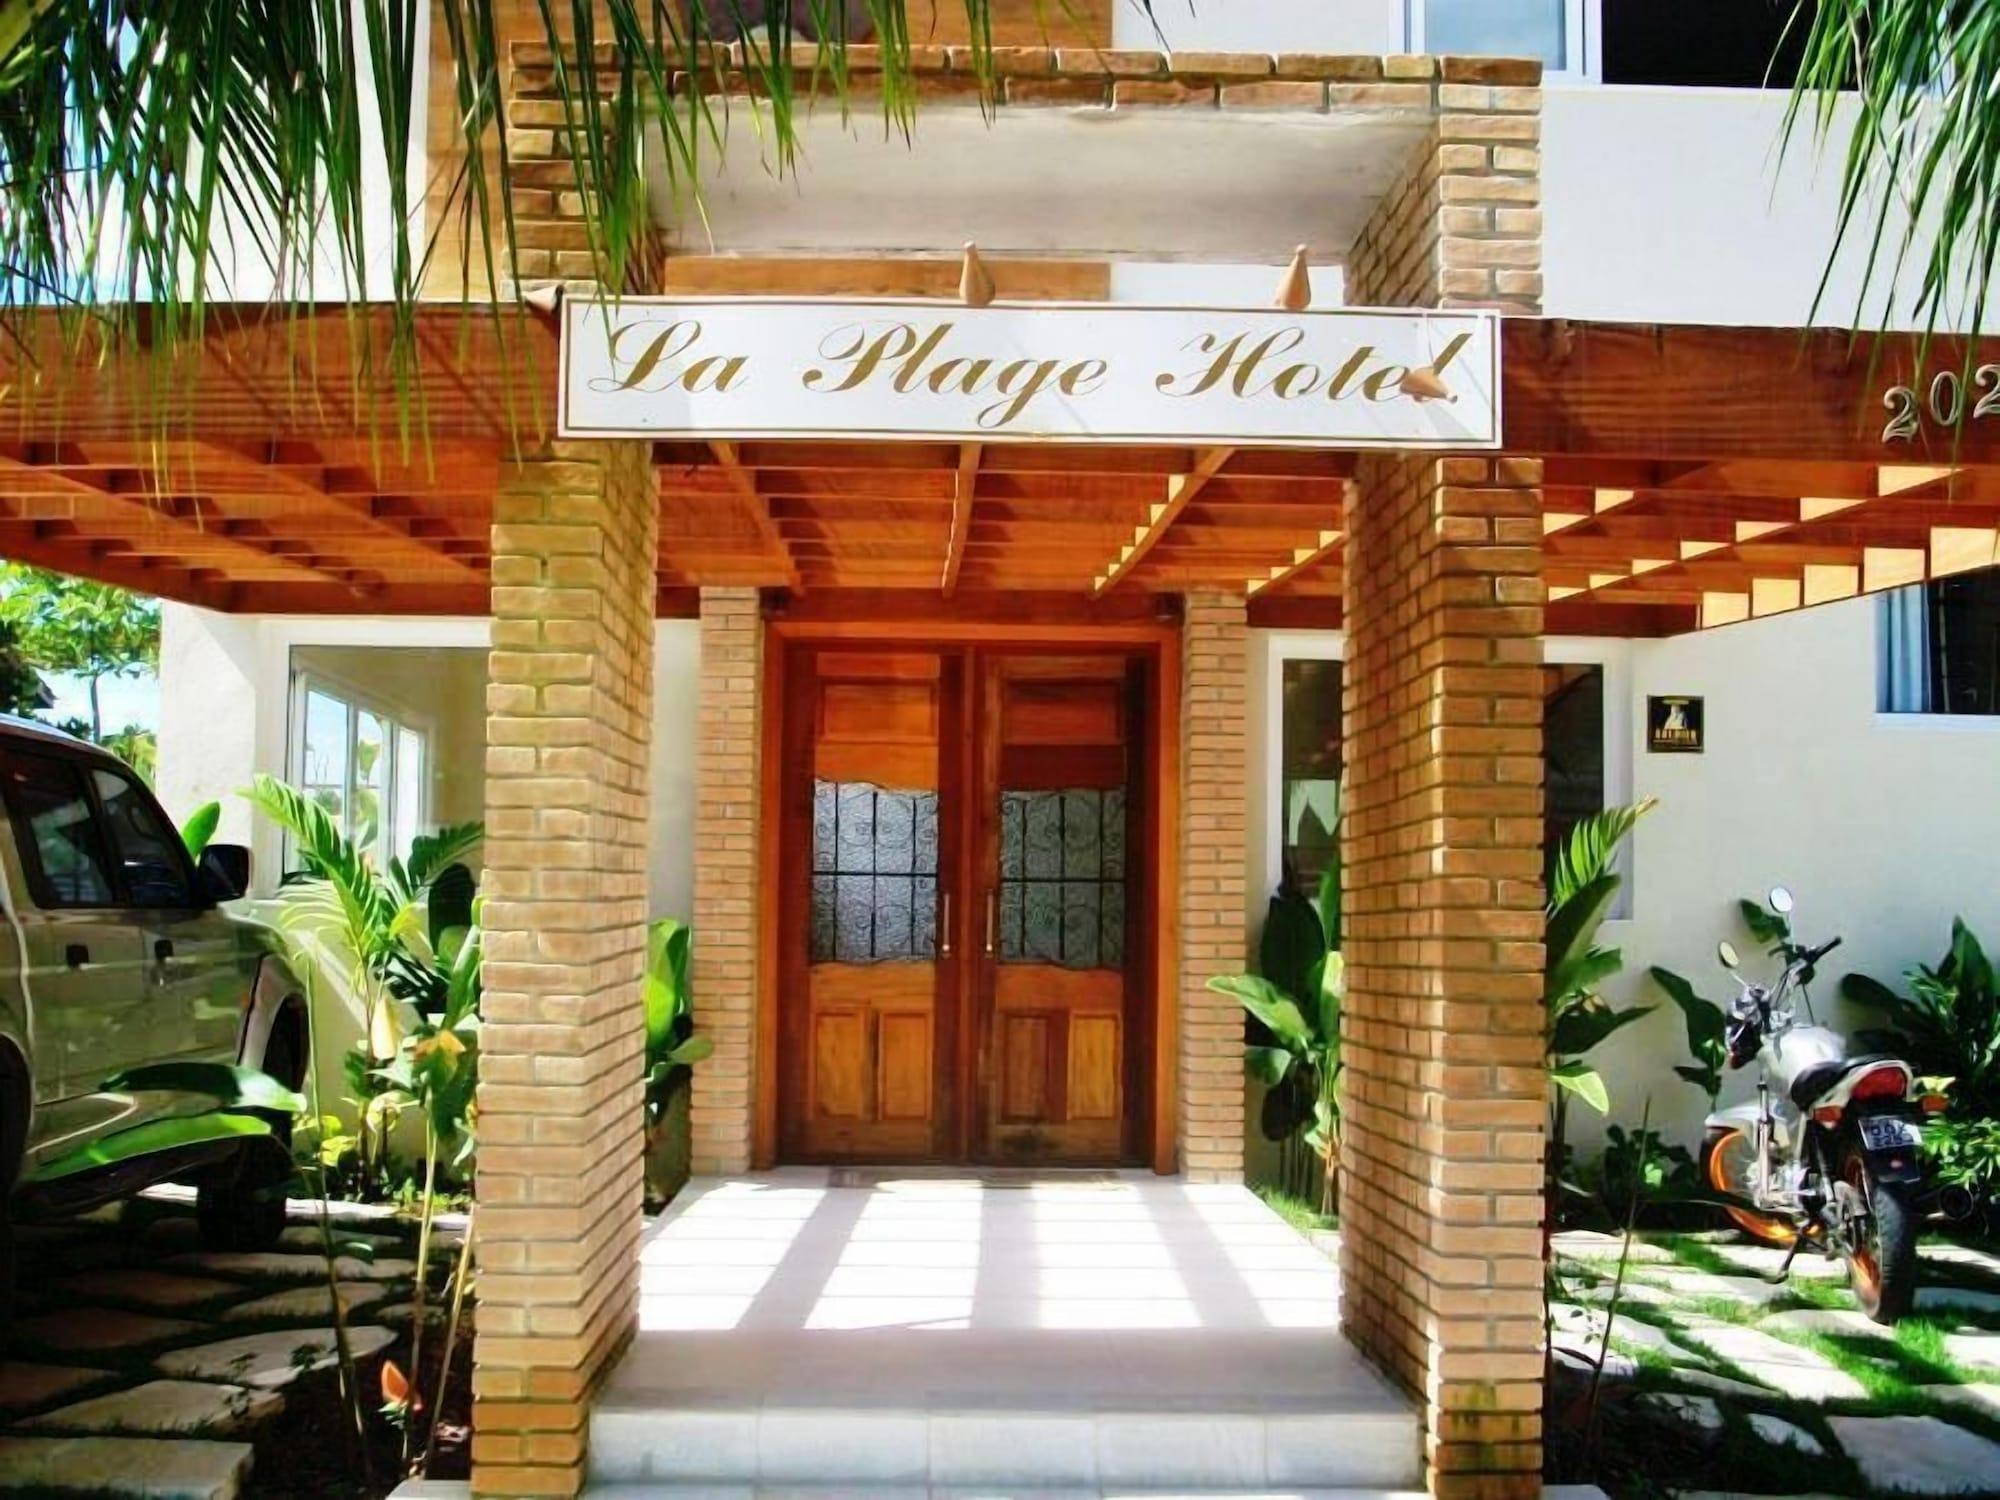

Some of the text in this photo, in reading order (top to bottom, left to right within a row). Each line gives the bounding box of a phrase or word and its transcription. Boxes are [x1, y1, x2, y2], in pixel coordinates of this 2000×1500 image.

[588, 319, 749, 393] La
[803, 320, 1108, 428] Plage
[1881, 364, 2000, 443] 202
